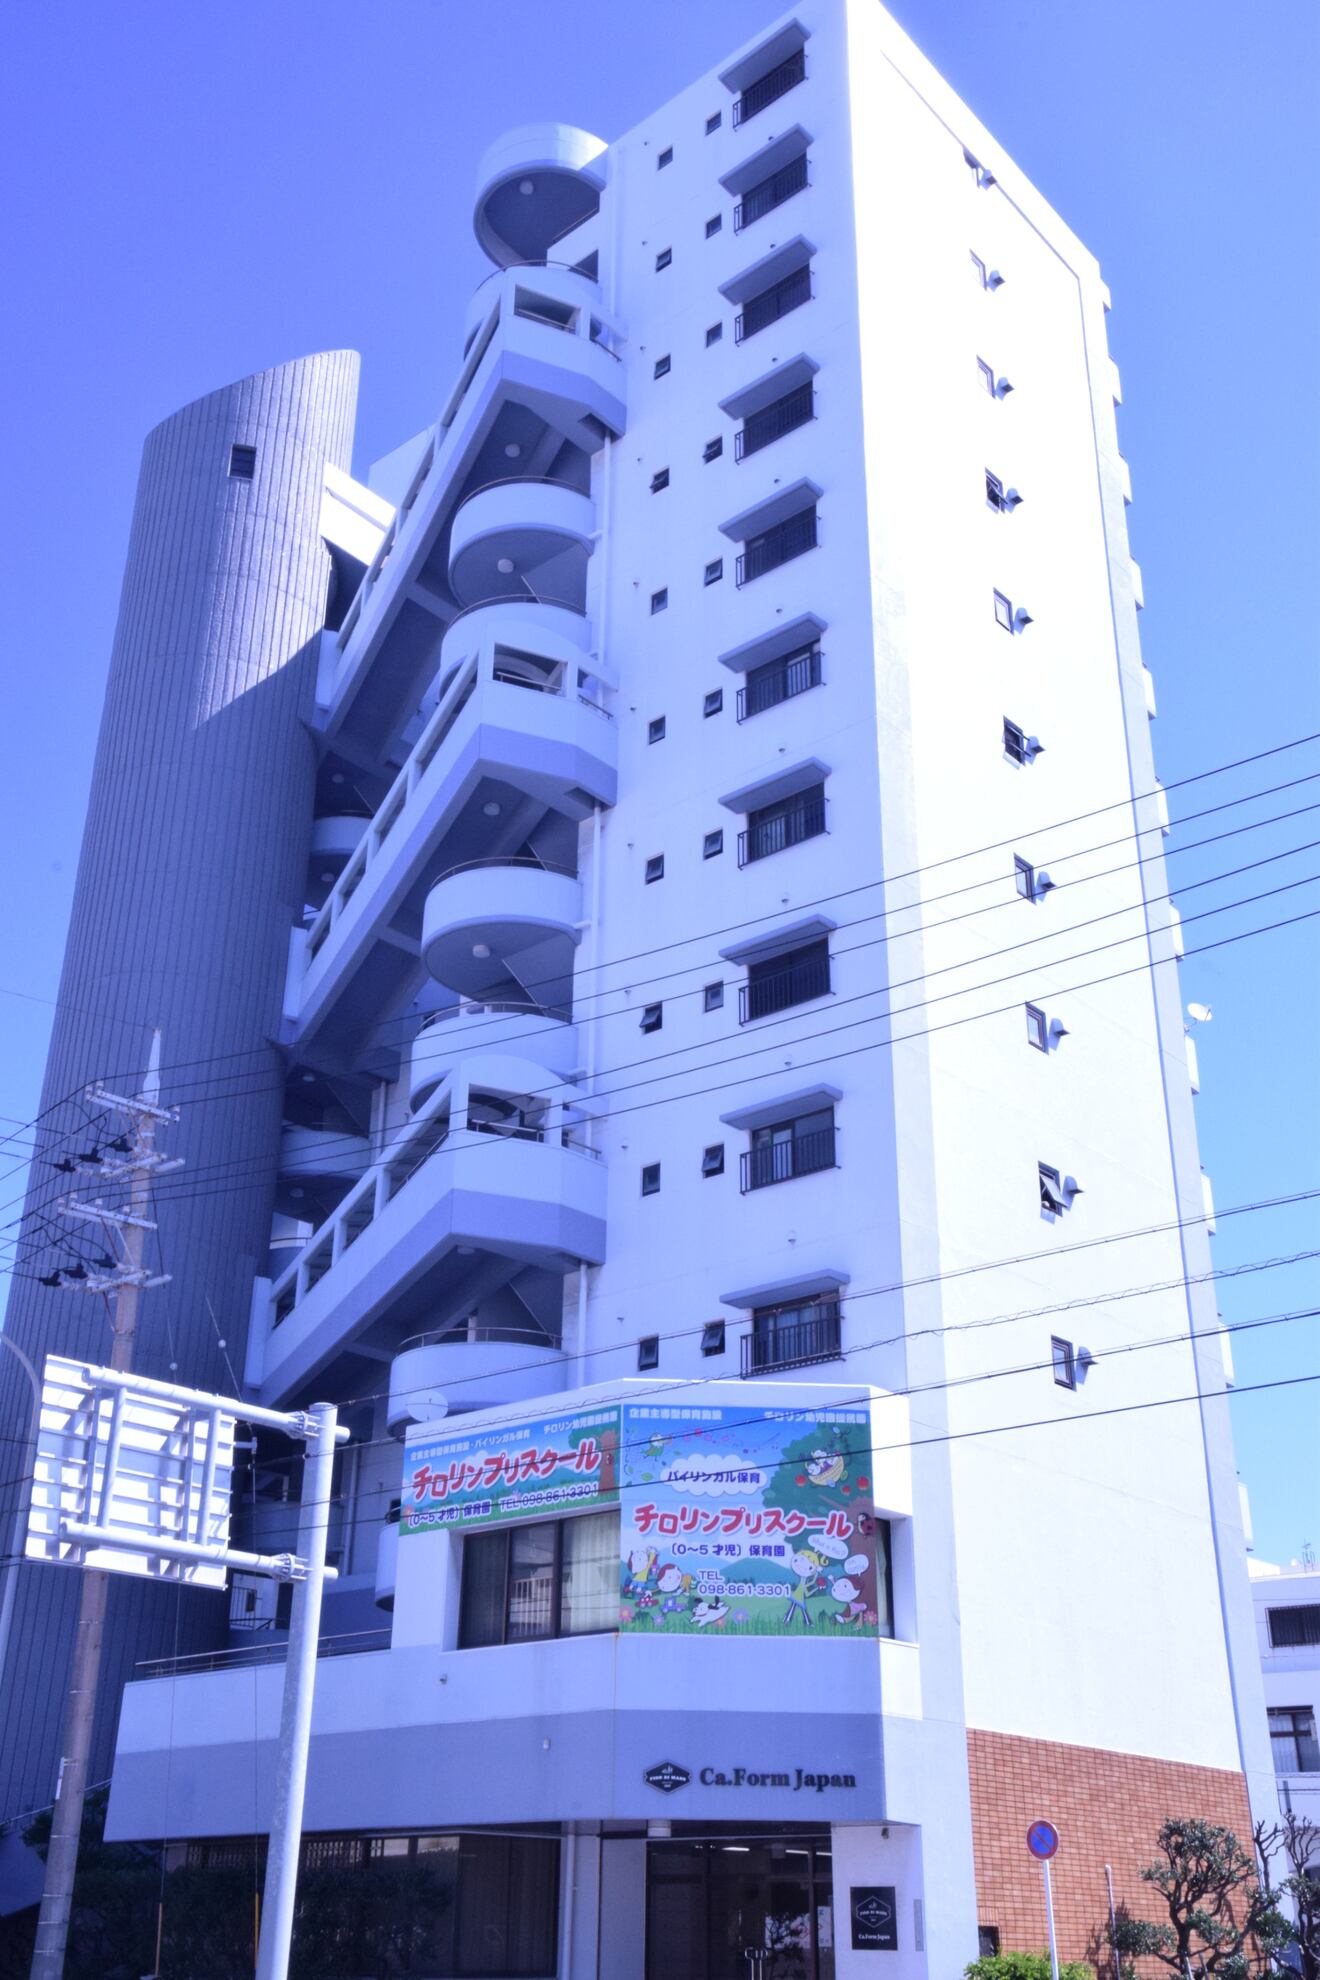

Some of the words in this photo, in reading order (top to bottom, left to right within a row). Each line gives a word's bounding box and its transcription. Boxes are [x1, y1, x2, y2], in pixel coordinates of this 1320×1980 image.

[412, 1439, 600, 1500] チロリンプリスクール
[667, 1470, 761, 1484] バイリンガル保育
[634, 1503, 851, 1537] チロリンプリスクール
[749, 1544, 786, 1557] 保育園
[699, 1570, 723, 1581] TEL
[700, 1767, 790, 1787] Ca.Form
[794, 1768, 856, 1793] Japan
